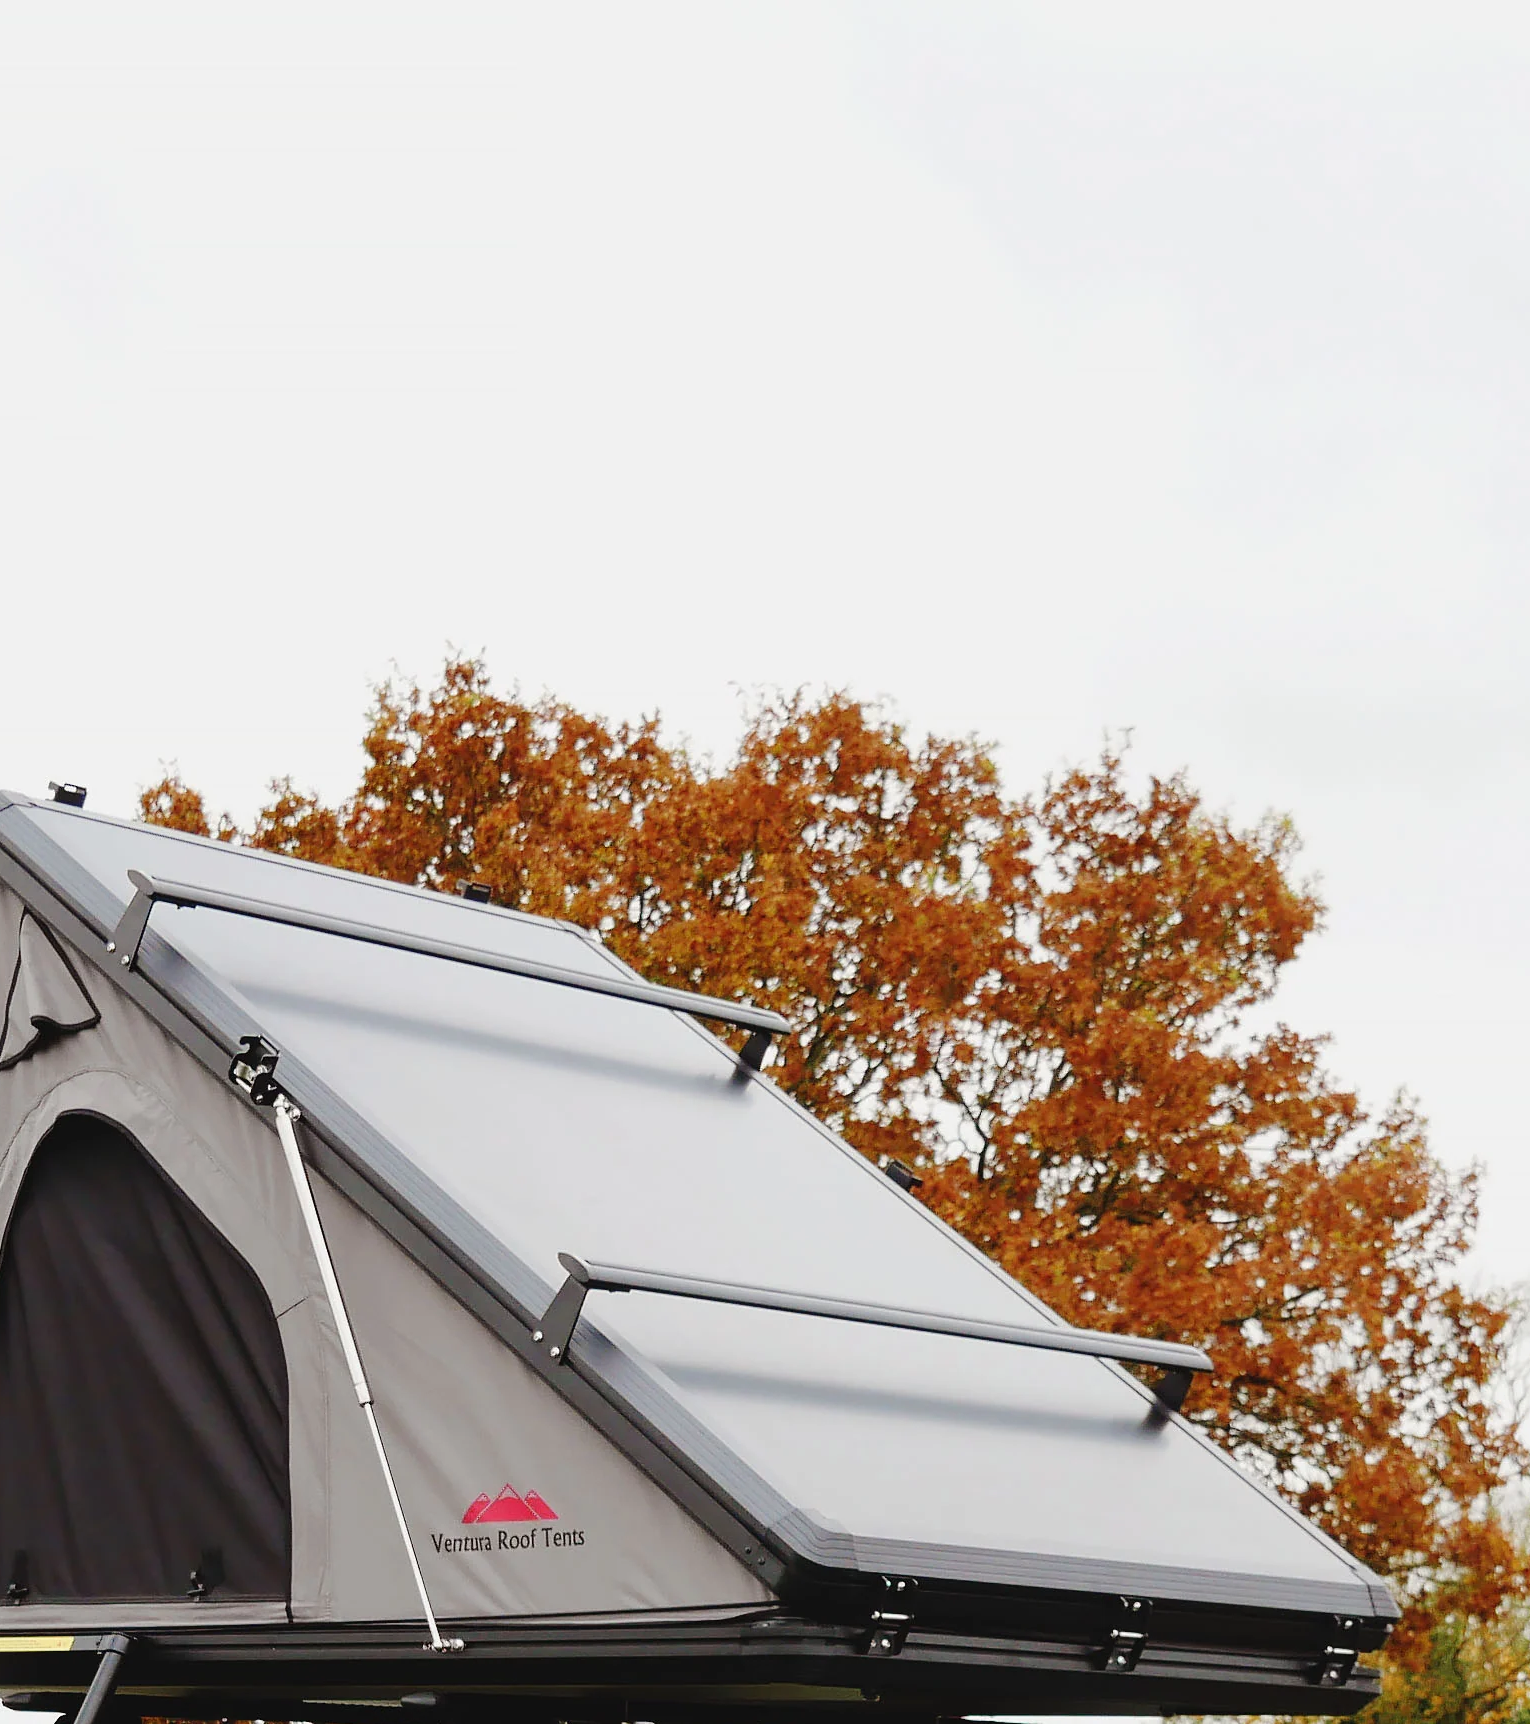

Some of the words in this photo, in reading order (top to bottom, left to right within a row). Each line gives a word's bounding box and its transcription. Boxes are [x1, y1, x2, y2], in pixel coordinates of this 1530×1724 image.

[431, 1533, 492, 1553] Ventura
[498, 1528, 537, 1550] Roof
[542, 1527, 585, 1547] Tents
